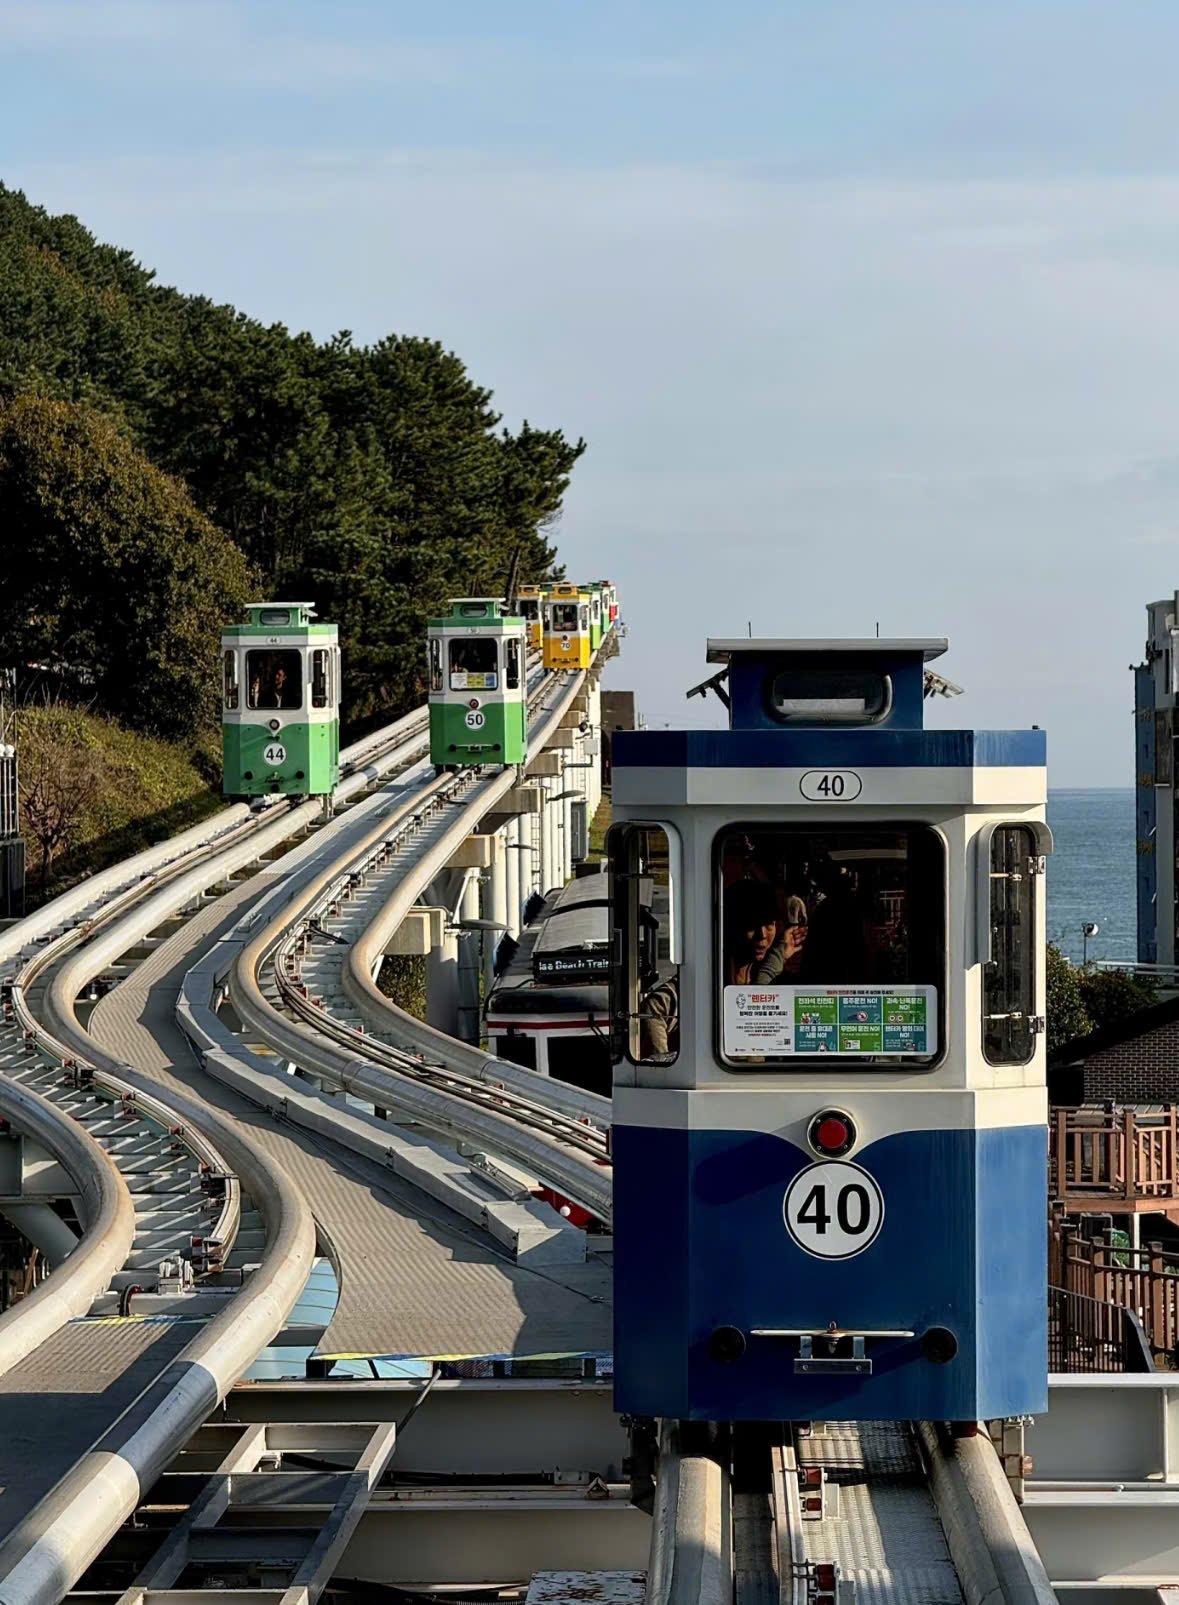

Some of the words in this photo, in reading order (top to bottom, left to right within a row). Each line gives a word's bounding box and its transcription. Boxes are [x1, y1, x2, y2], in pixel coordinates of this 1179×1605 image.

[467, 714, 483, 726] 50
[266, 748, 284, 761] 44
[817, 775, 844, 796] 40
[797, 1184, 870, 1235] 40
